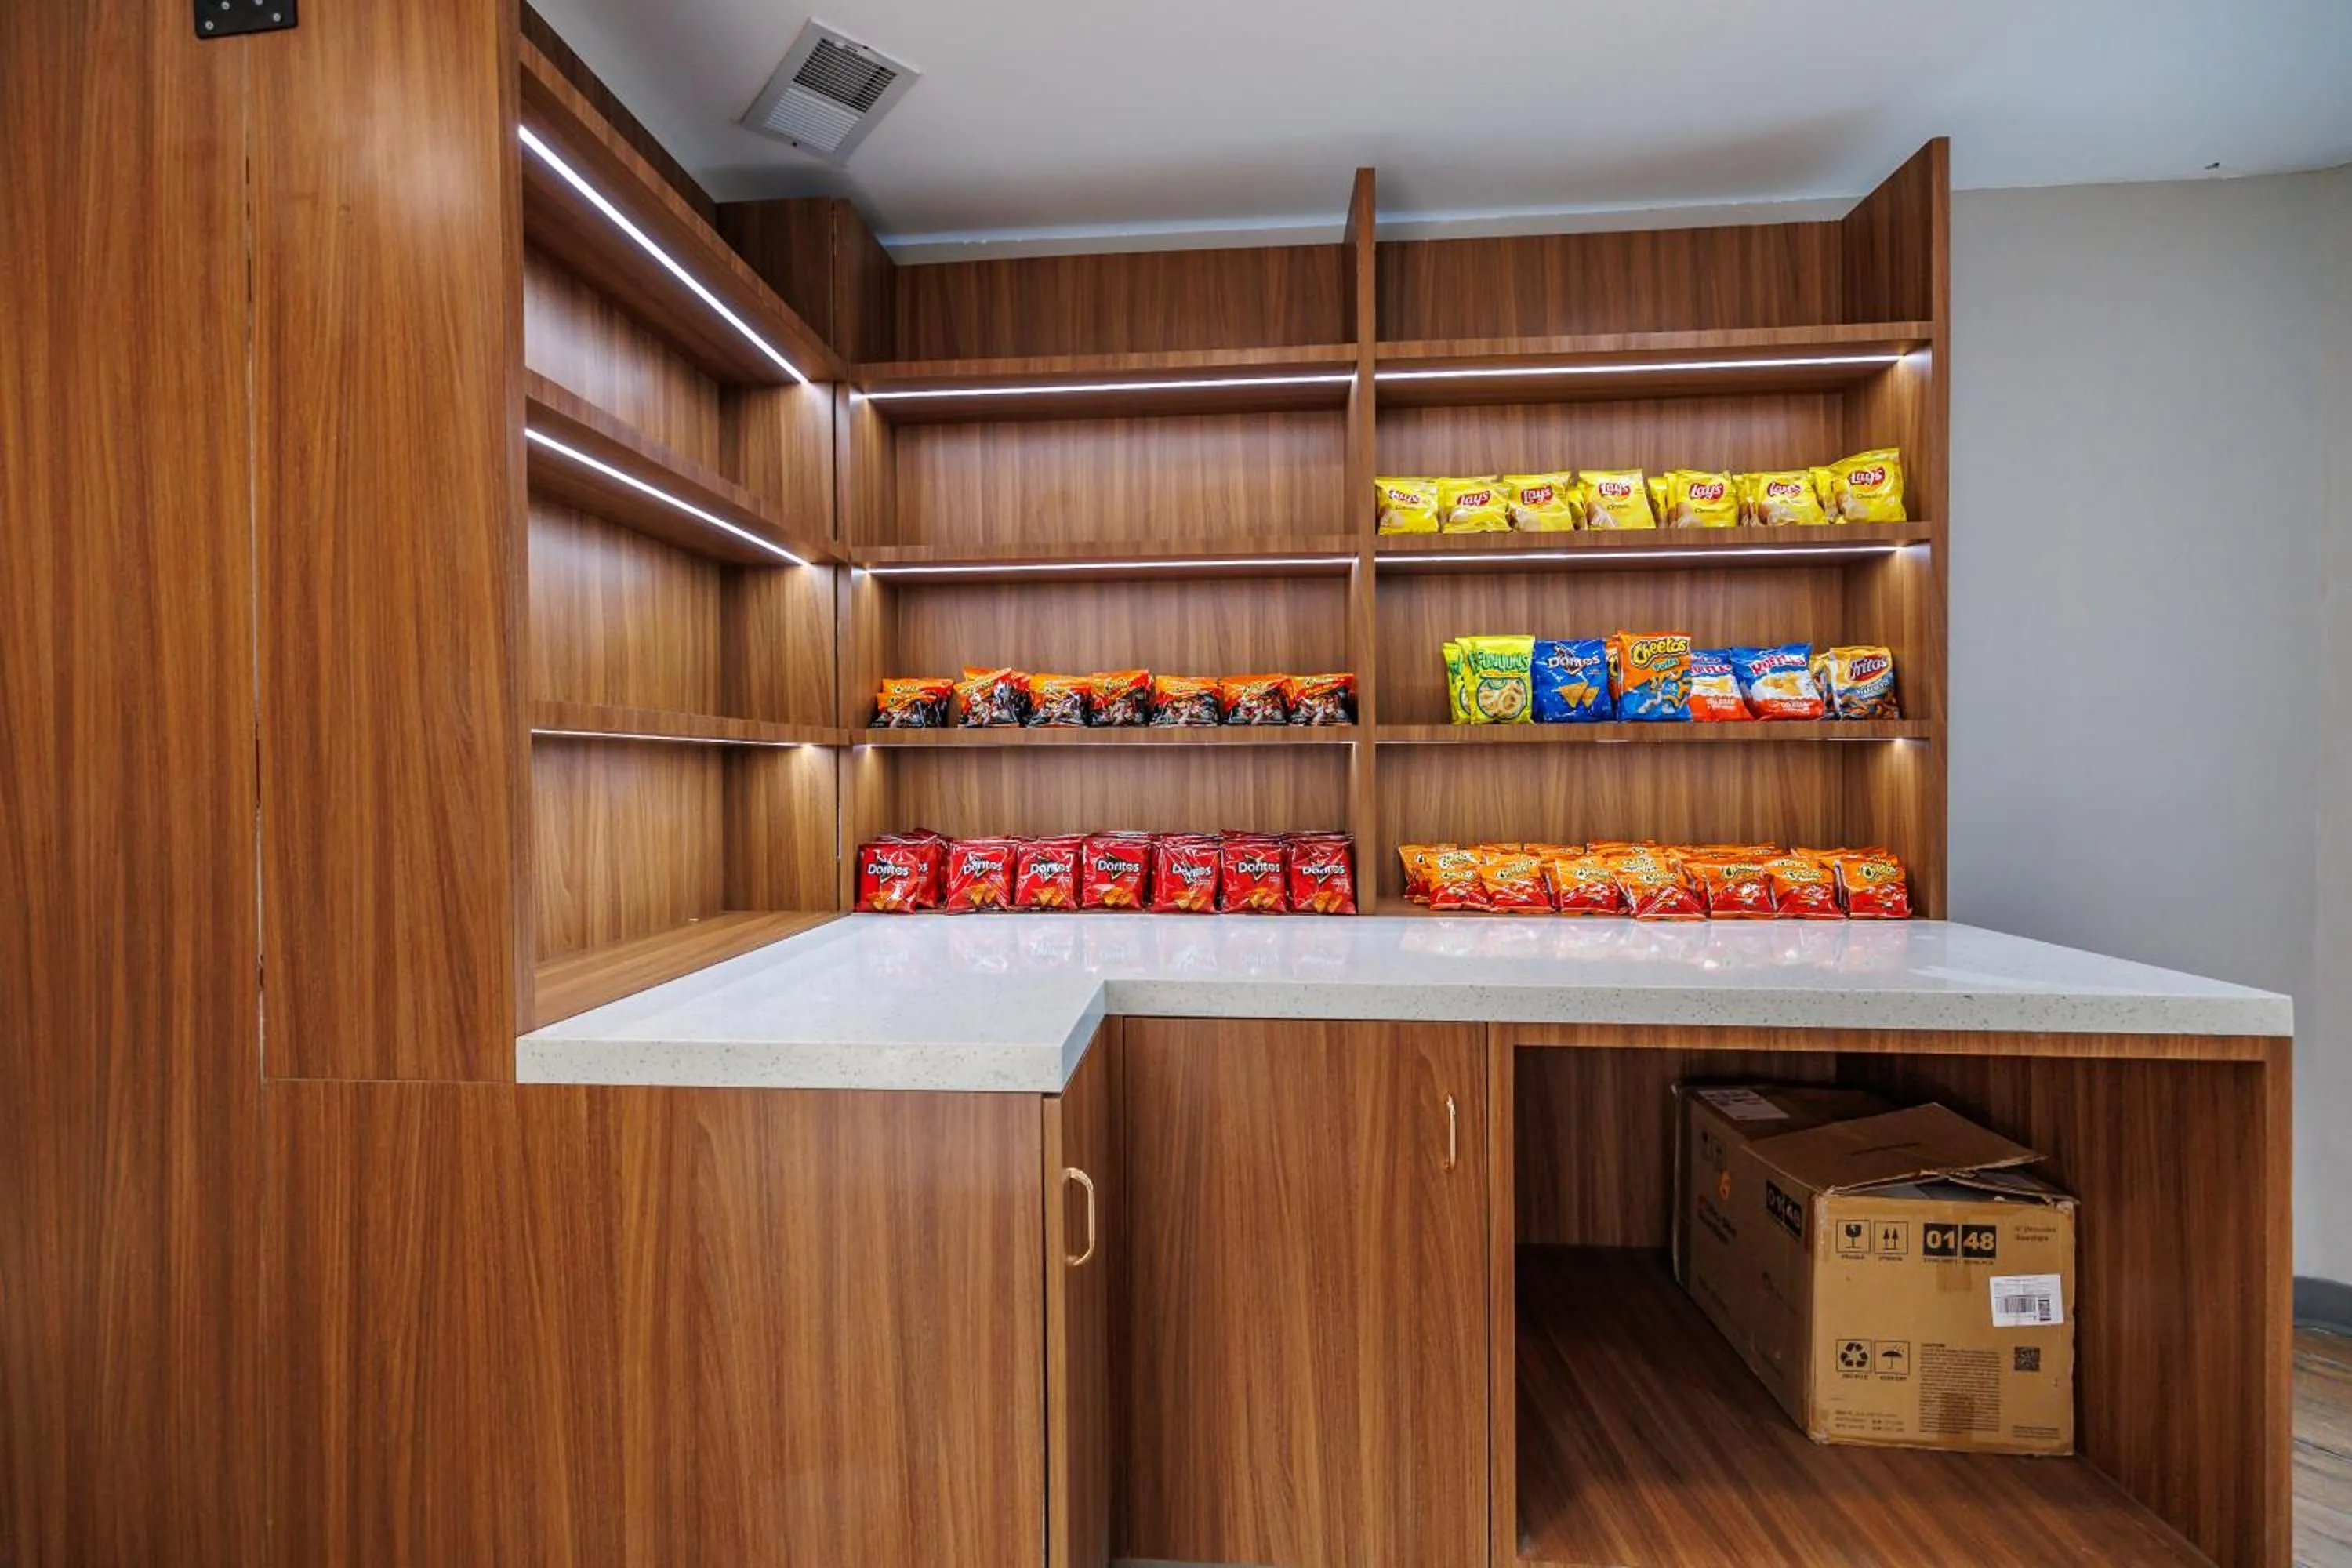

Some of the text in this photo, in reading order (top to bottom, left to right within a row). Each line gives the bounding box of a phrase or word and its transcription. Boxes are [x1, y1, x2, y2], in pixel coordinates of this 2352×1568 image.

[1632, 638, 1687, 666] Cheetos
[1479, 652, 1529, 672] FUNYUNS
[867, 862, 910, 877] Doritos
[1097, 859, 1140, 873] Doritos
[1237, 861, 1281, 873] Doritos
[1926, 1229, 1955, 1249] 01
[1963, 1231, 1995, 1251] 48
